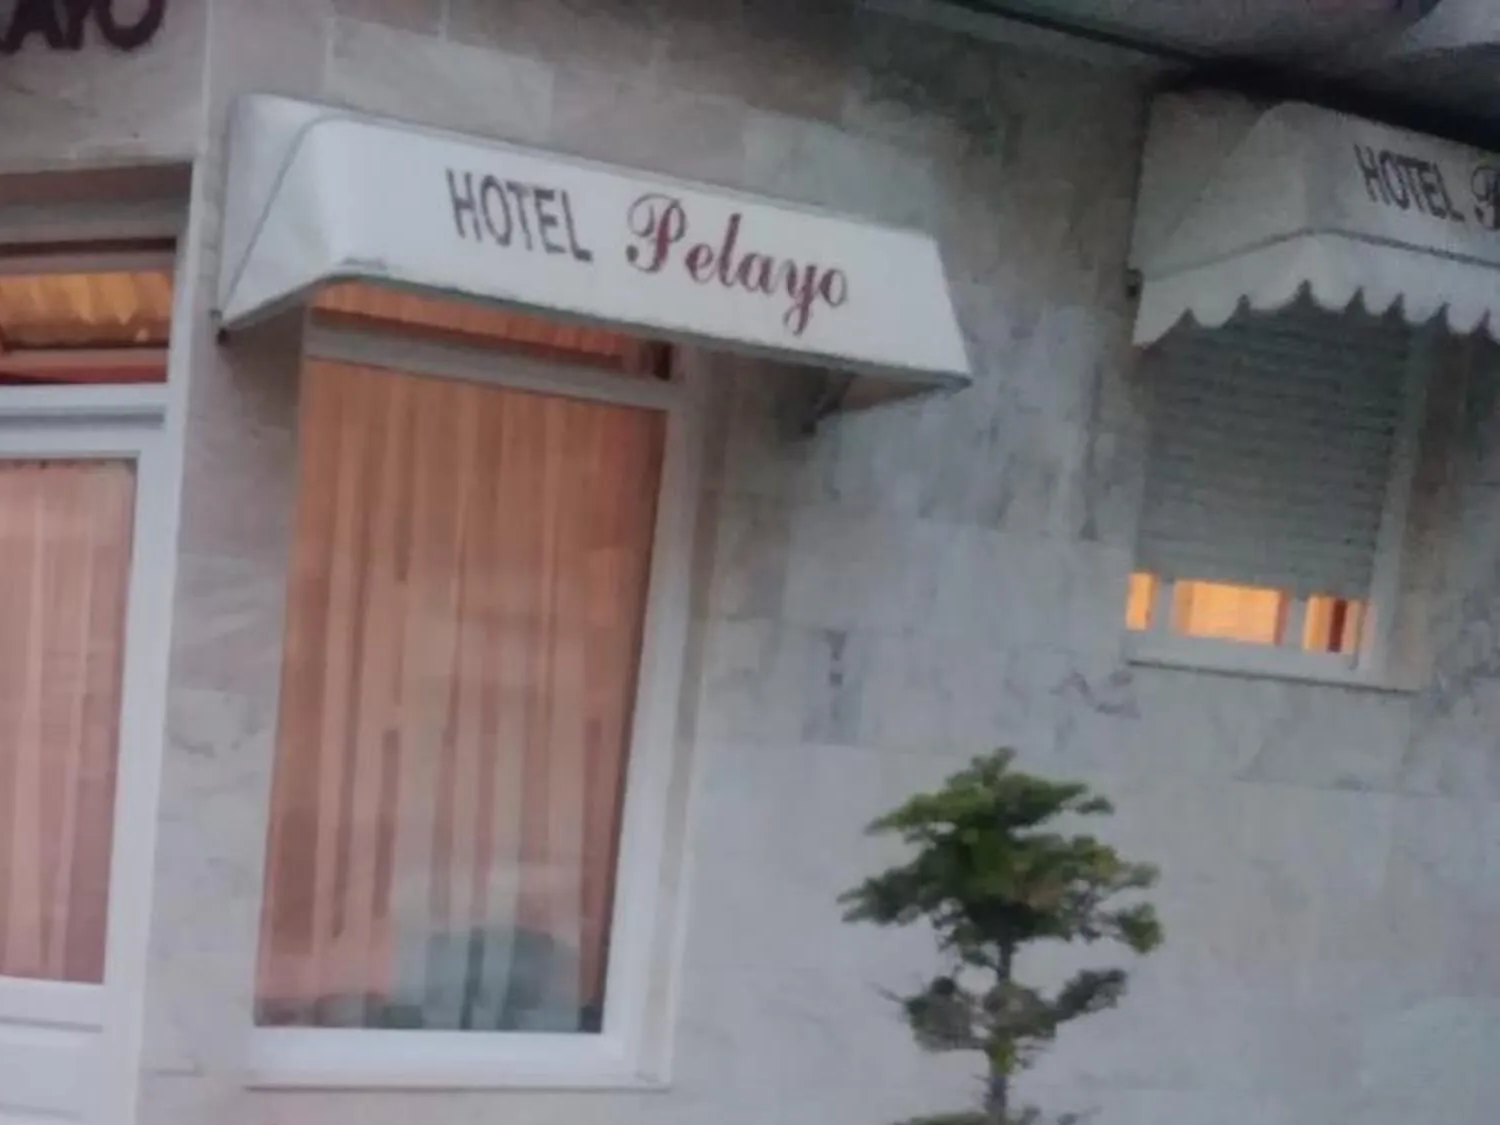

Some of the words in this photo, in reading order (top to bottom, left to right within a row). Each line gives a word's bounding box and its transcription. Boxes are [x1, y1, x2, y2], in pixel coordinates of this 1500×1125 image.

[1354, 144, 1466, 223] HOTEL
[445, 167, 594, 264] HOTEL
[625, 192, 849, 336] Pelayo
